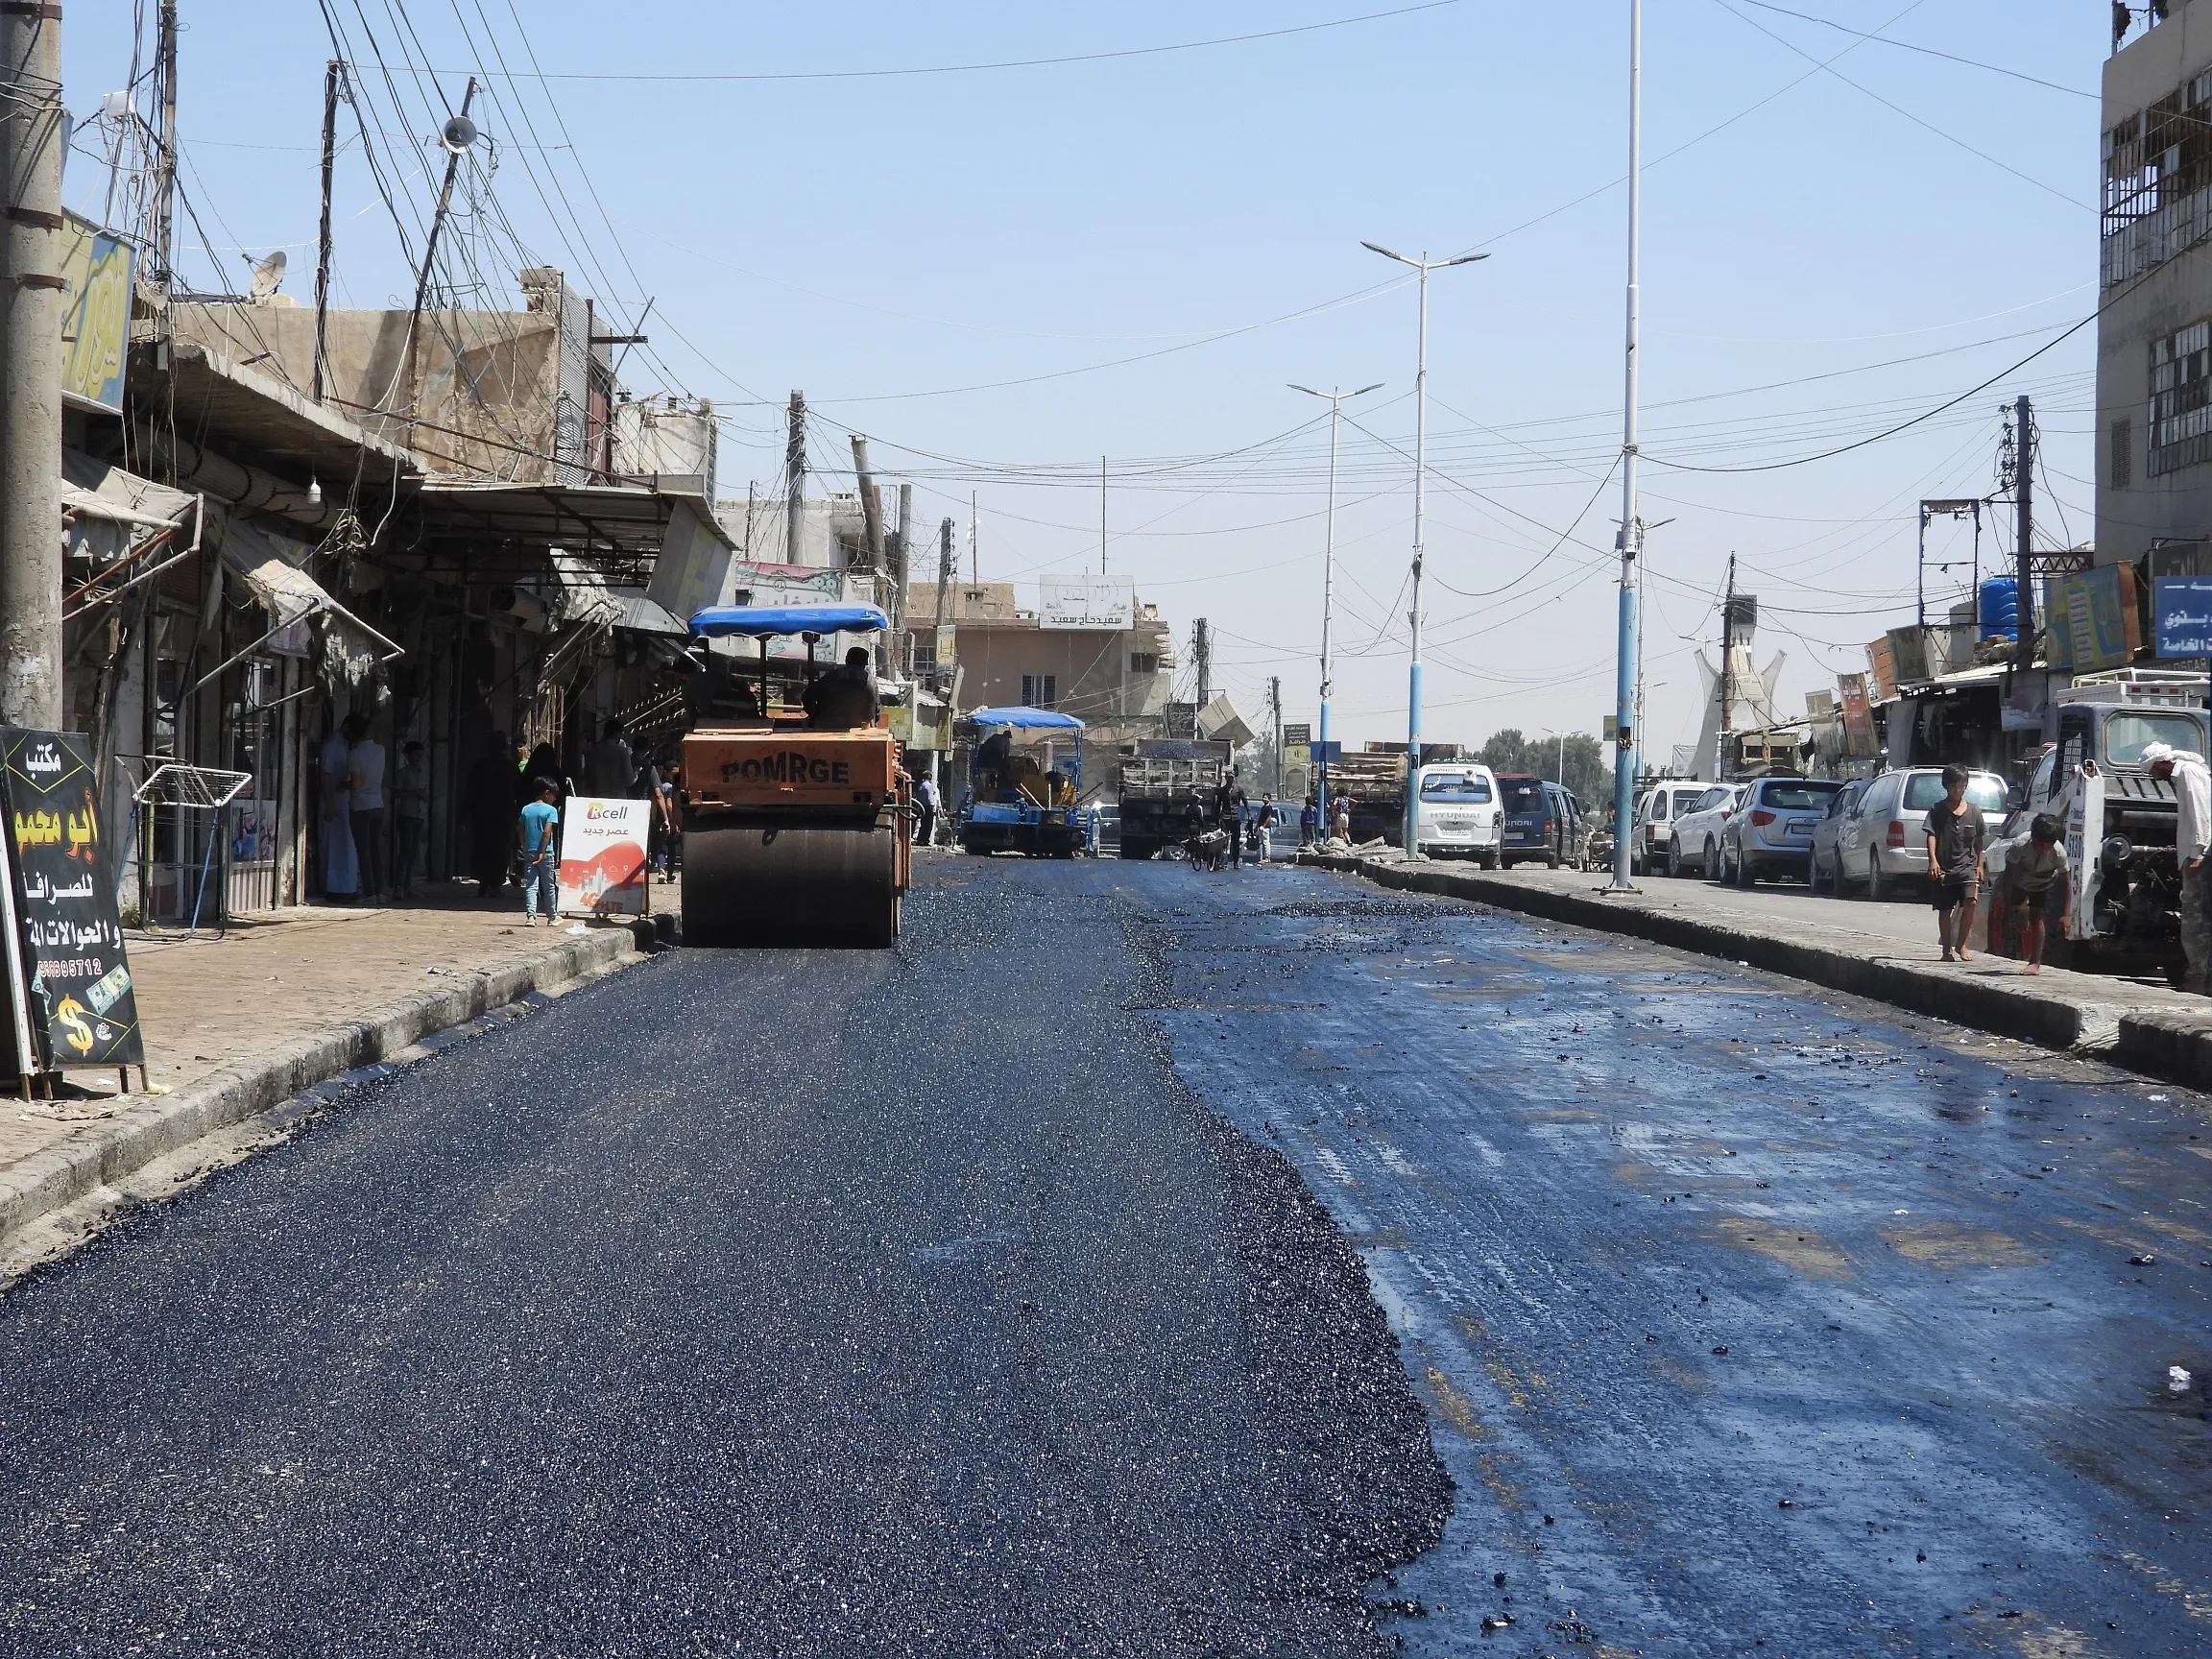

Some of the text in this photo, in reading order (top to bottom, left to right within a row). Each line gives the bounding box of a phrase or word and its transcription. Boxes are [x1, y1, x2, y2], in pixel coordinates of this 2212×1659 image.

[25, 742, 61, 781] مكتب
[14, 786, 99, 864] أبو محمو
[588, 804, 628, 819] Rcell
[583, 828, 604, 836] جديد
